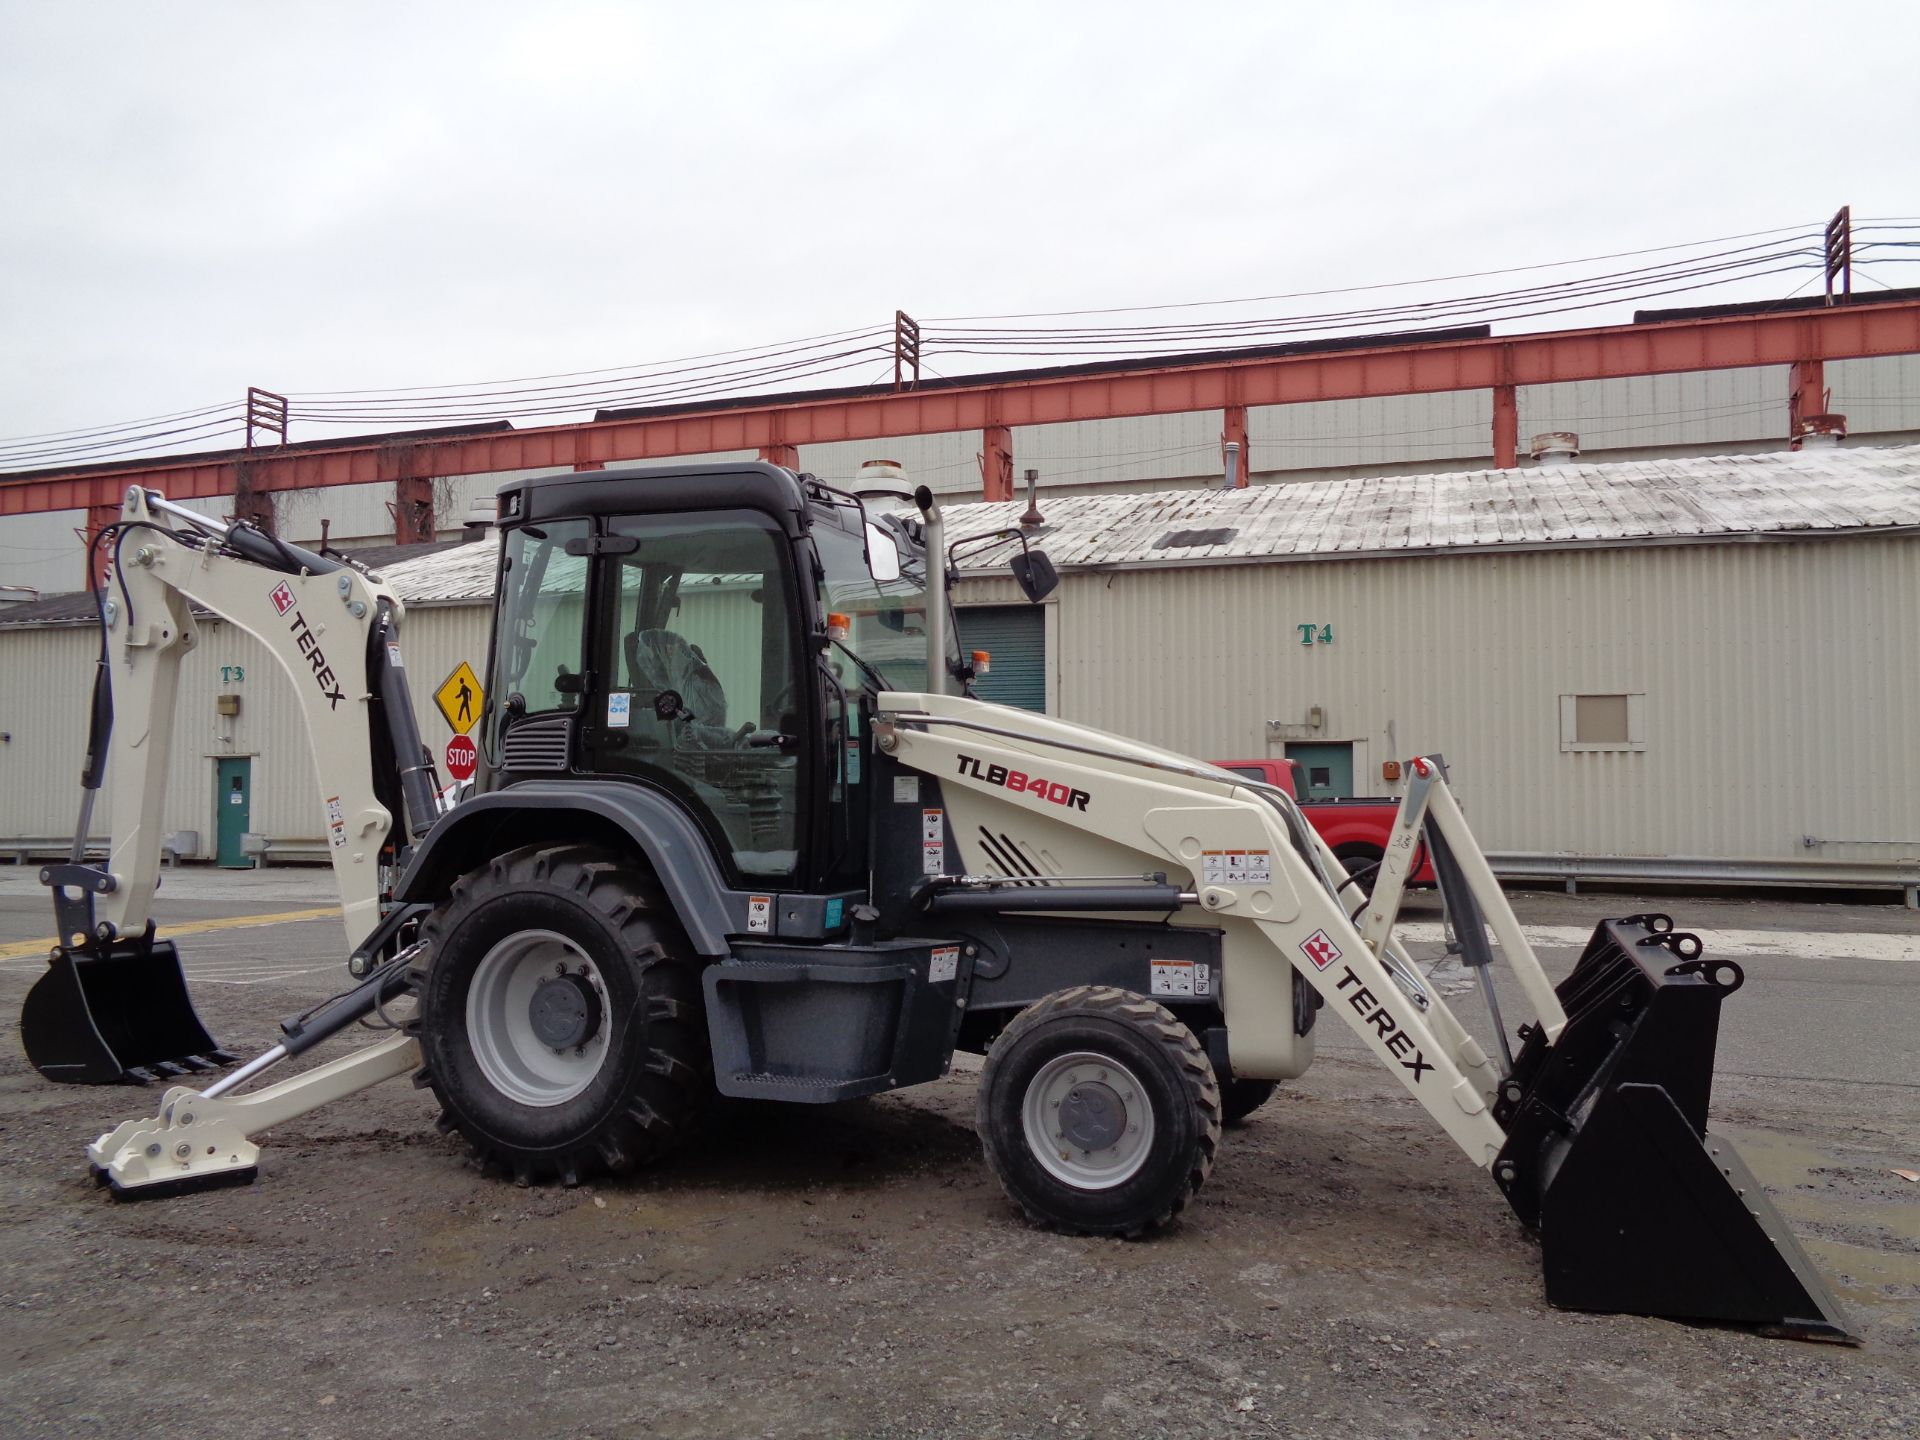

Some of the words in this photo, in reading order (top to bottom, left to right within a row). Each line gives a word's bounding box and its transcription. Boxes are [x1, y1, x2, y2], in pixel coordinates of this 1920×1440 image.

[1297, 624, 1333, 645] T4
[220, 665, 245, 684] T3
[289, 611, 347, 711] TEREX
[448, 748, 476, 767] STOP
[957, 753, 1091, 812] TLB840R
[1336, 965, 1436, 1084] TEREX
